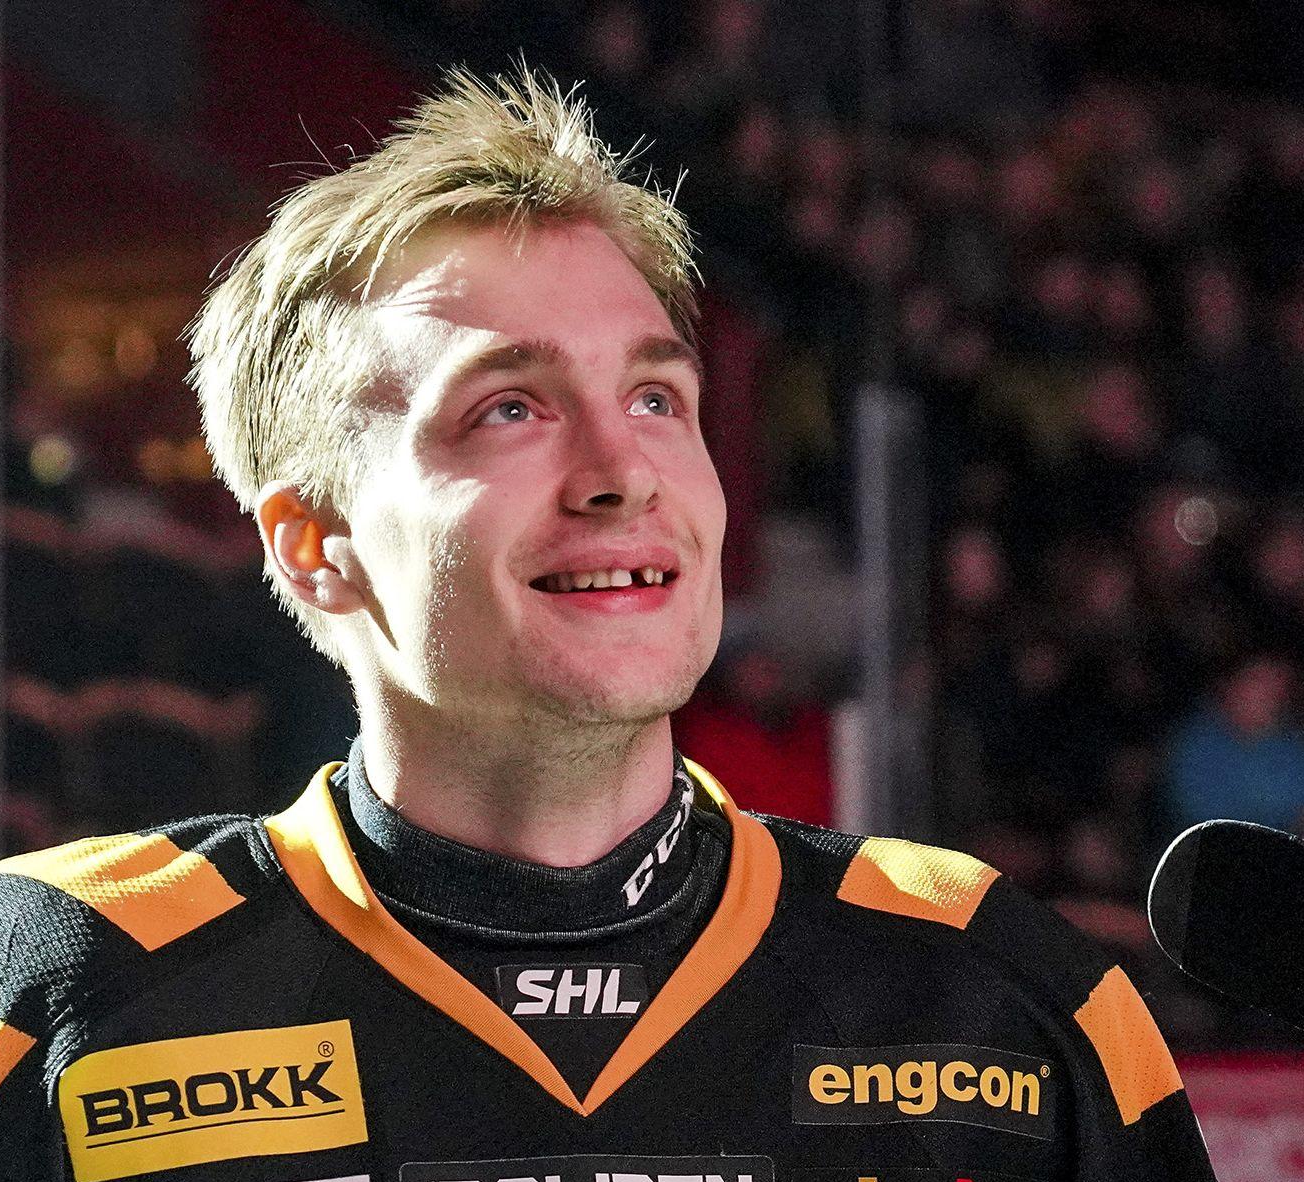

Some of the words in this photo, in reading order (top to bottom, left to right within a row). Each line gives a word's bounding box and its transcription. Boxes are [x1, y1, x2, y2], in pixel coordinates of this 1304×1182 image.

[512, 968, 640, 1016] SHL
[76, 1059, 345, 1138] BROKK
[808, 1060, 1041, 1116] engcon
